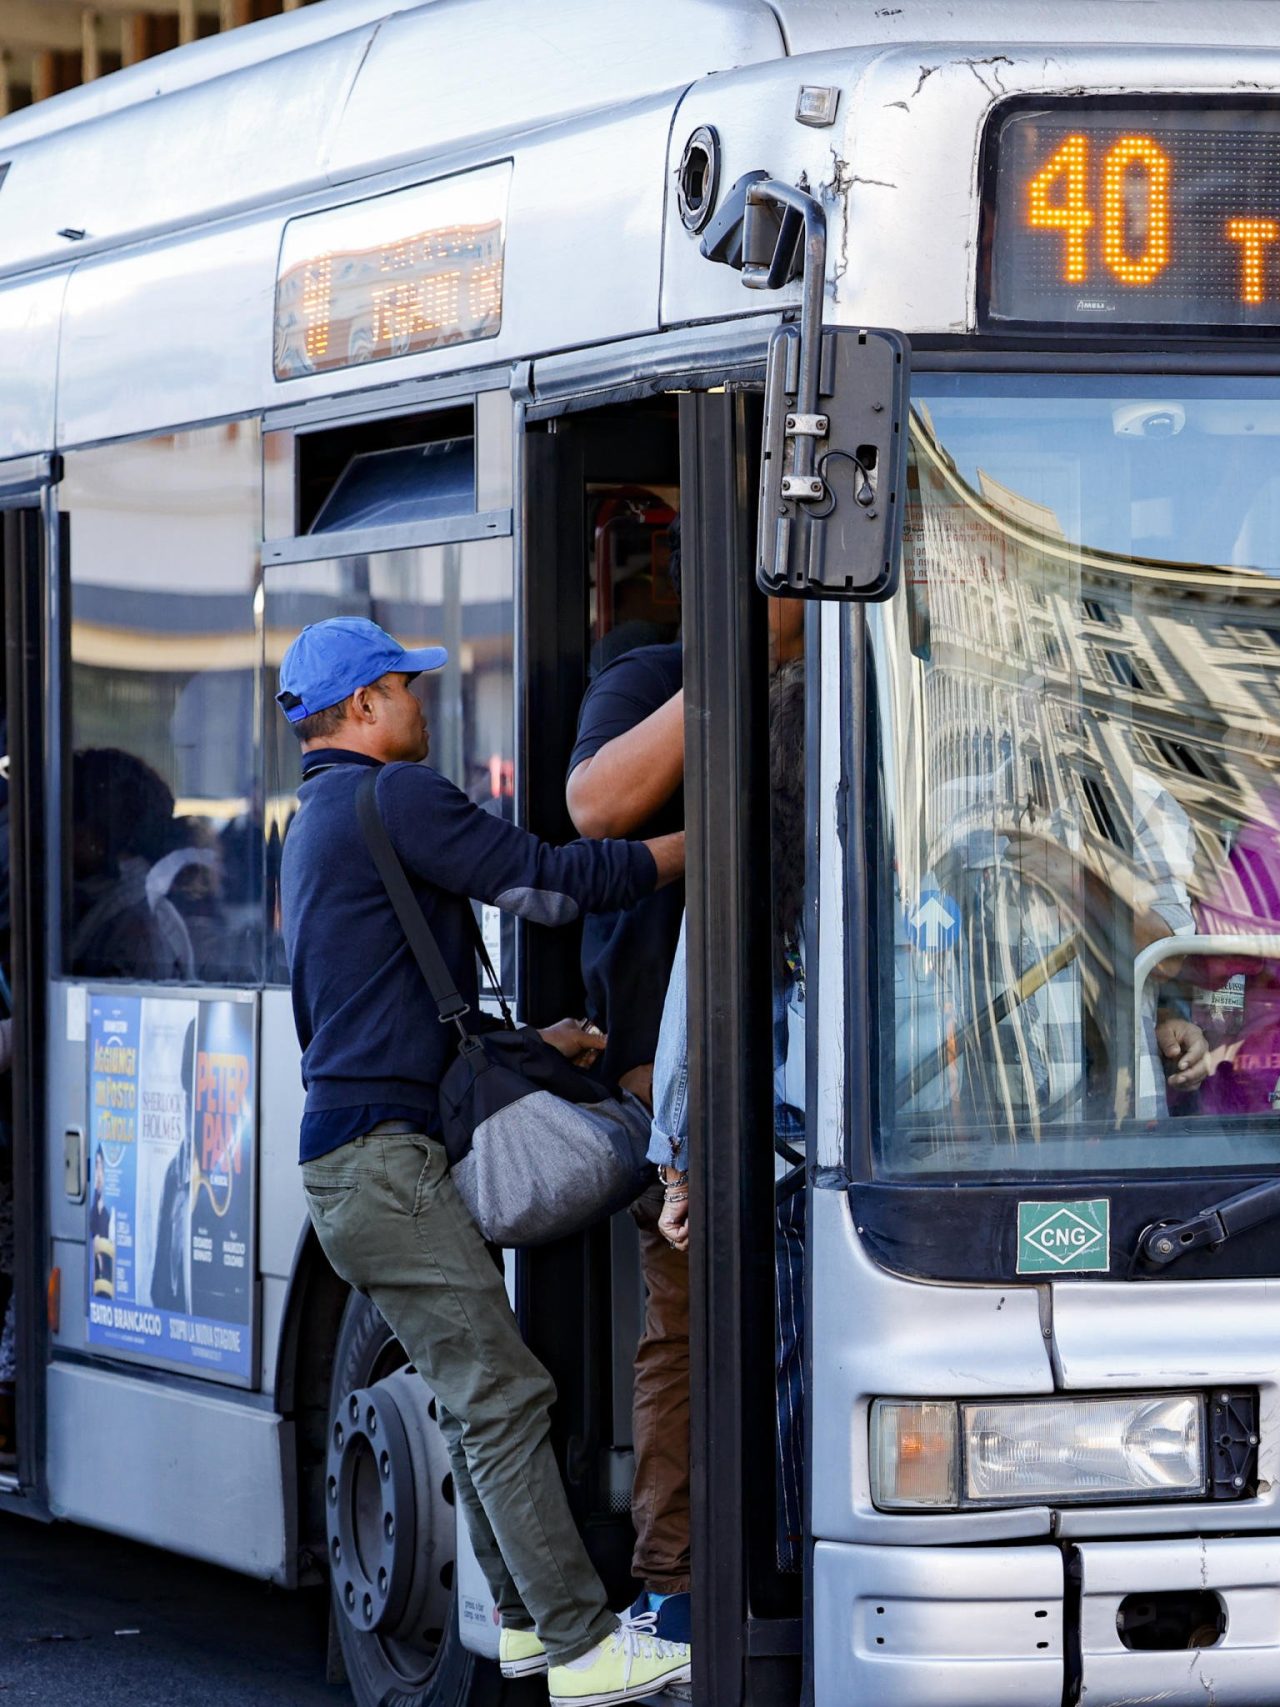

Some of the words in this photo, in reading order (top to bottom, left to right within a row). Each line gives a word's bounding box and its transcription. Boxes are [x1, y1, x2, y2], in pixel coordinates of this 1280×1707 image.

[1028, 134, 1168, 284] 40
[196, 1052, 249, 1115] PETER
[142, 1091, 182, 1114] SHERLOCK
[142, 1114, 182, 1141] HOLMES
[202, 1112, 242, 1174] PAN
[1040, 1227, 1086, 1247] CNG
[114, 1307, 162, 1337] BRANCACCIO
